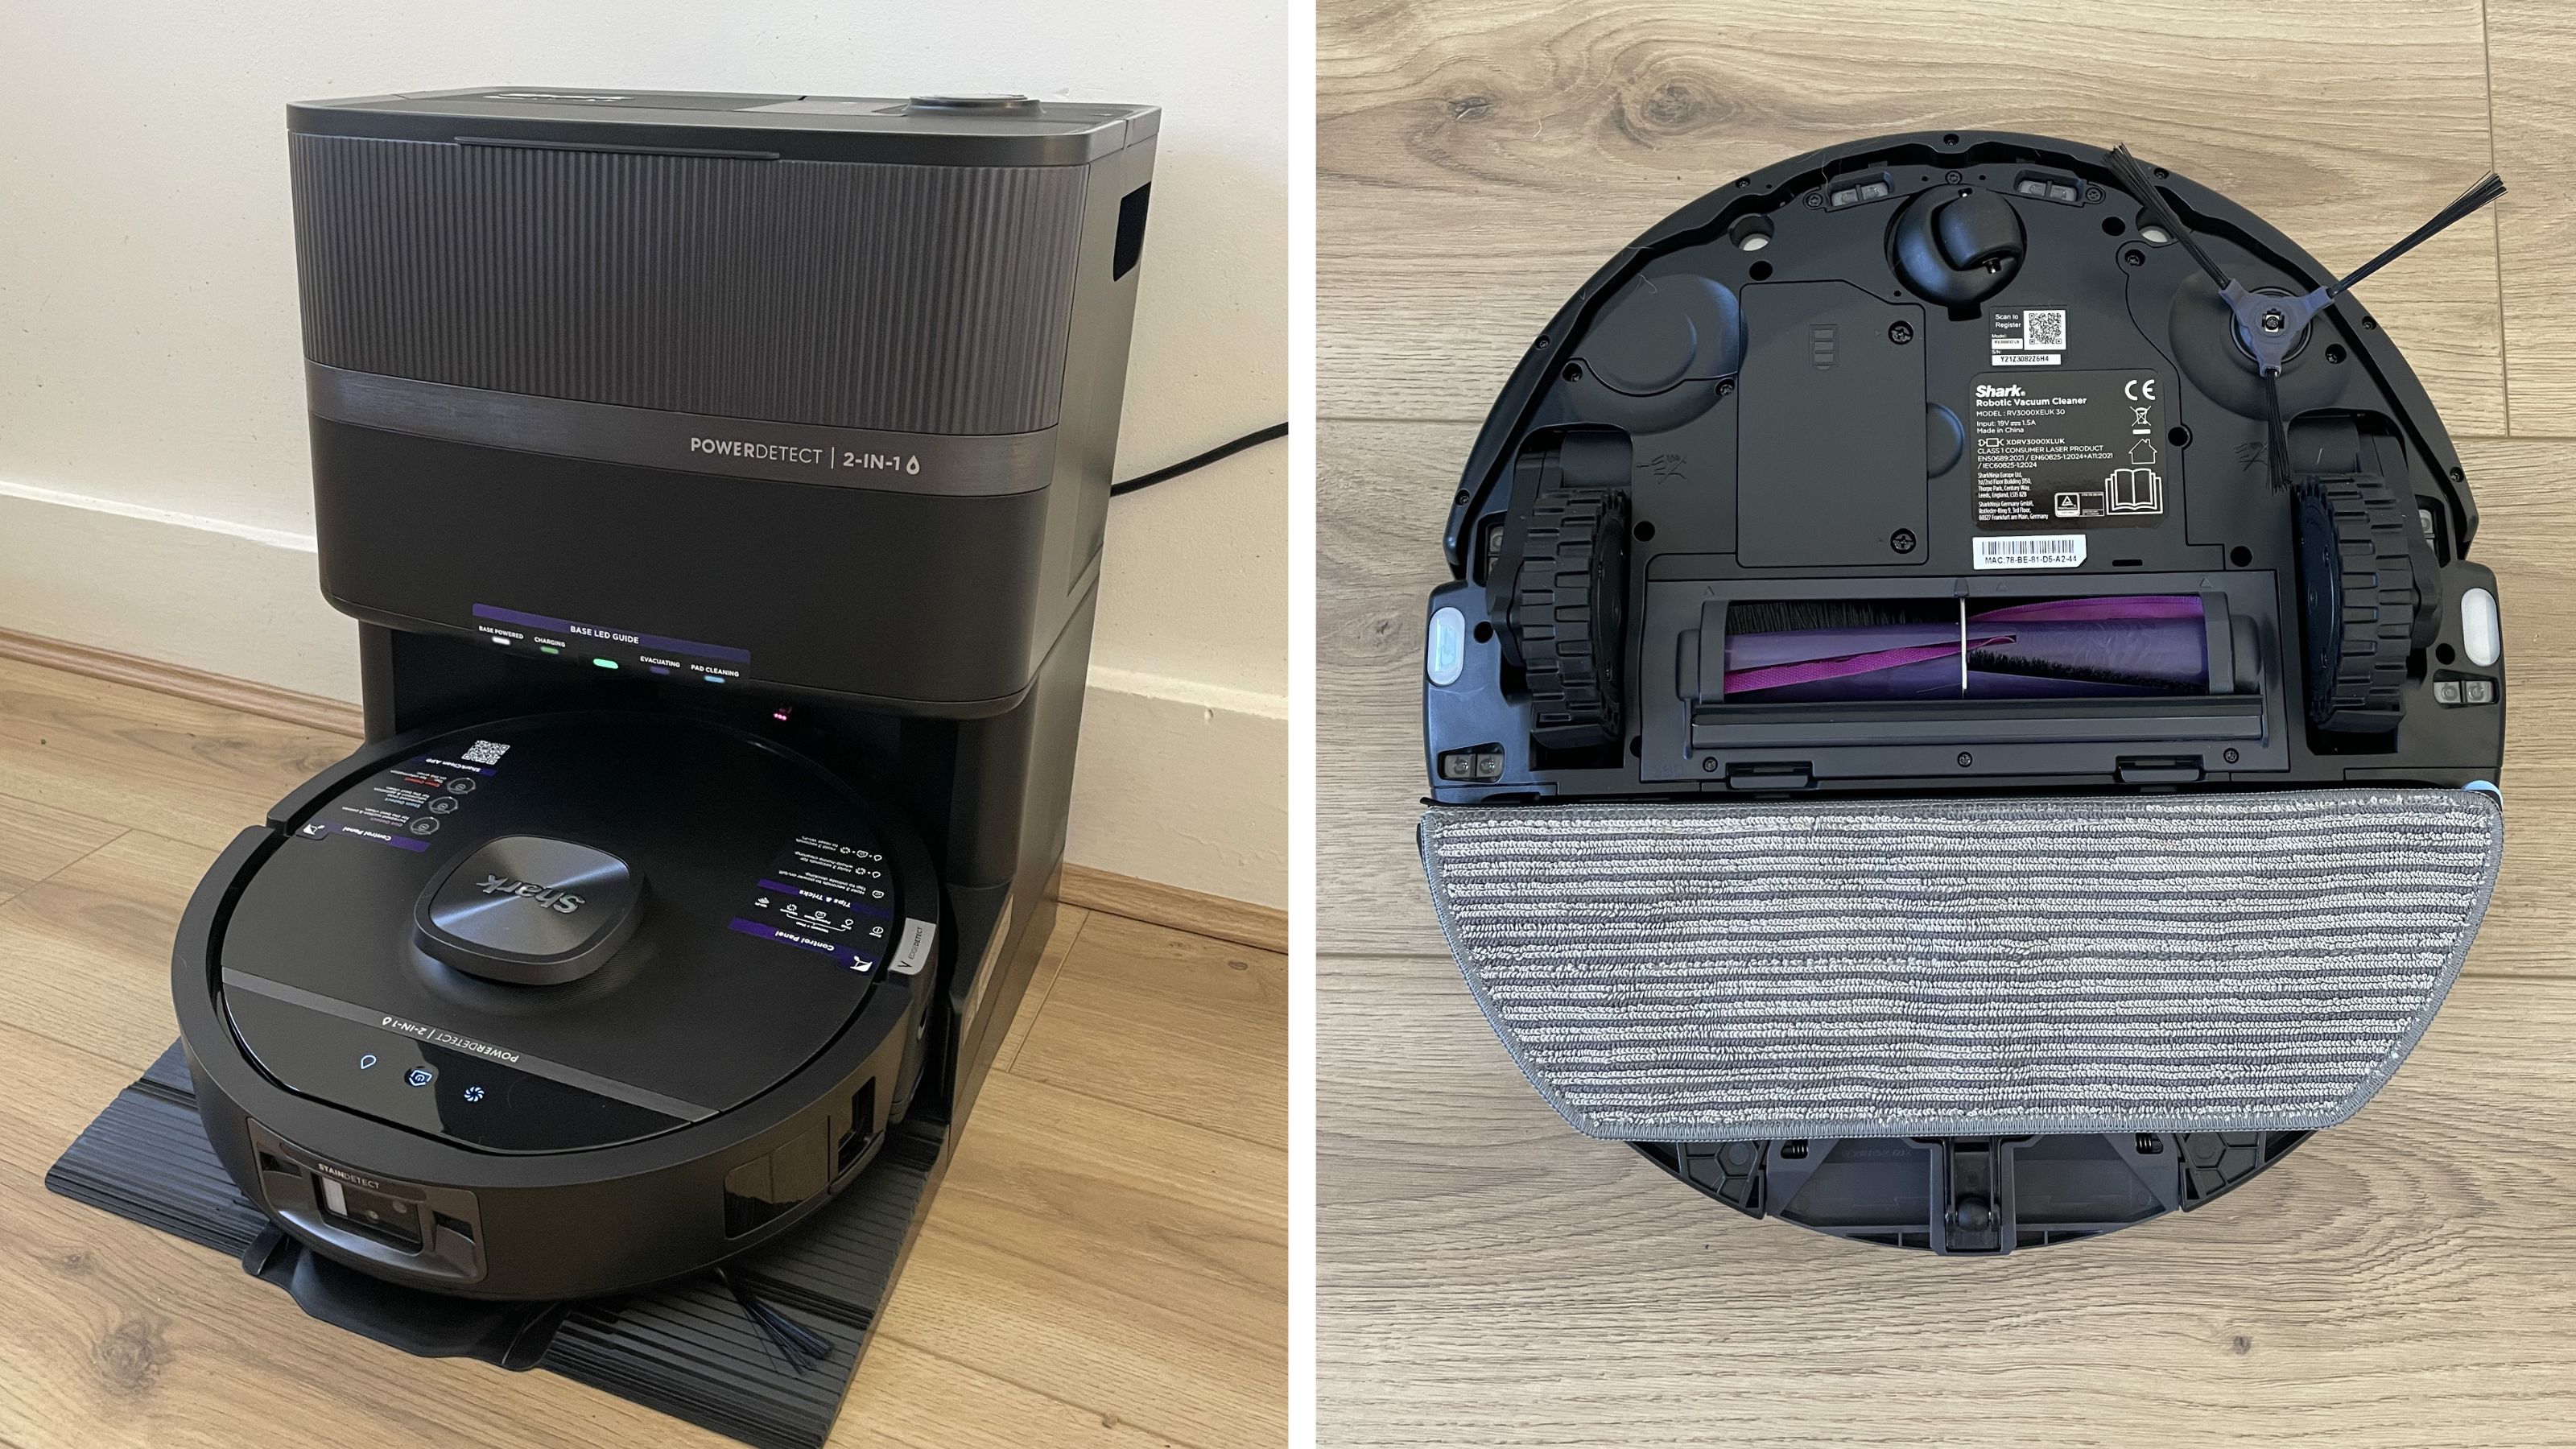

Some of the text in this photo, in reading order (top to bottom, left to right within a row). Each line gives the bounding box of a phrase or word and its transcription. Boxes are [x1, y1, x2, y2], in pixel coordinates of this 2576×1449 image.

[1995, 321, 2021, 329] Register
[1976, 399, 2013, 407] Robotic
[2052, 397, 2087, 405] Cleaner
[2006, 438, 2066, 446] XDRV3000XLUK
[691, 437, 901, 471] POWERDETECT 2-IN-1
[478, 625, 524, 639] BASE POWERED
[570, 625, 639, 644] BASE LED GUIDE
[534, 636, 566, 648] CHARGING
[639, 655, 681, 668] EVACUATING
[691, 664, 740, 678] PAD CLEANING
[442, 761, 481, 773] SharkClean
[342, 826, 392, 841] Control Panel
[476, 874, 586, 914] Shark
[799, 890, 823, 901] Tricks
[833, 898, 851, 908] Tips
[774, 931, 835, 952] Control Panel
[392, 1020, 520, 1063] POWERDETECT 2-IN-1
[318, 1162, 380, 1190] STAINDETECT
